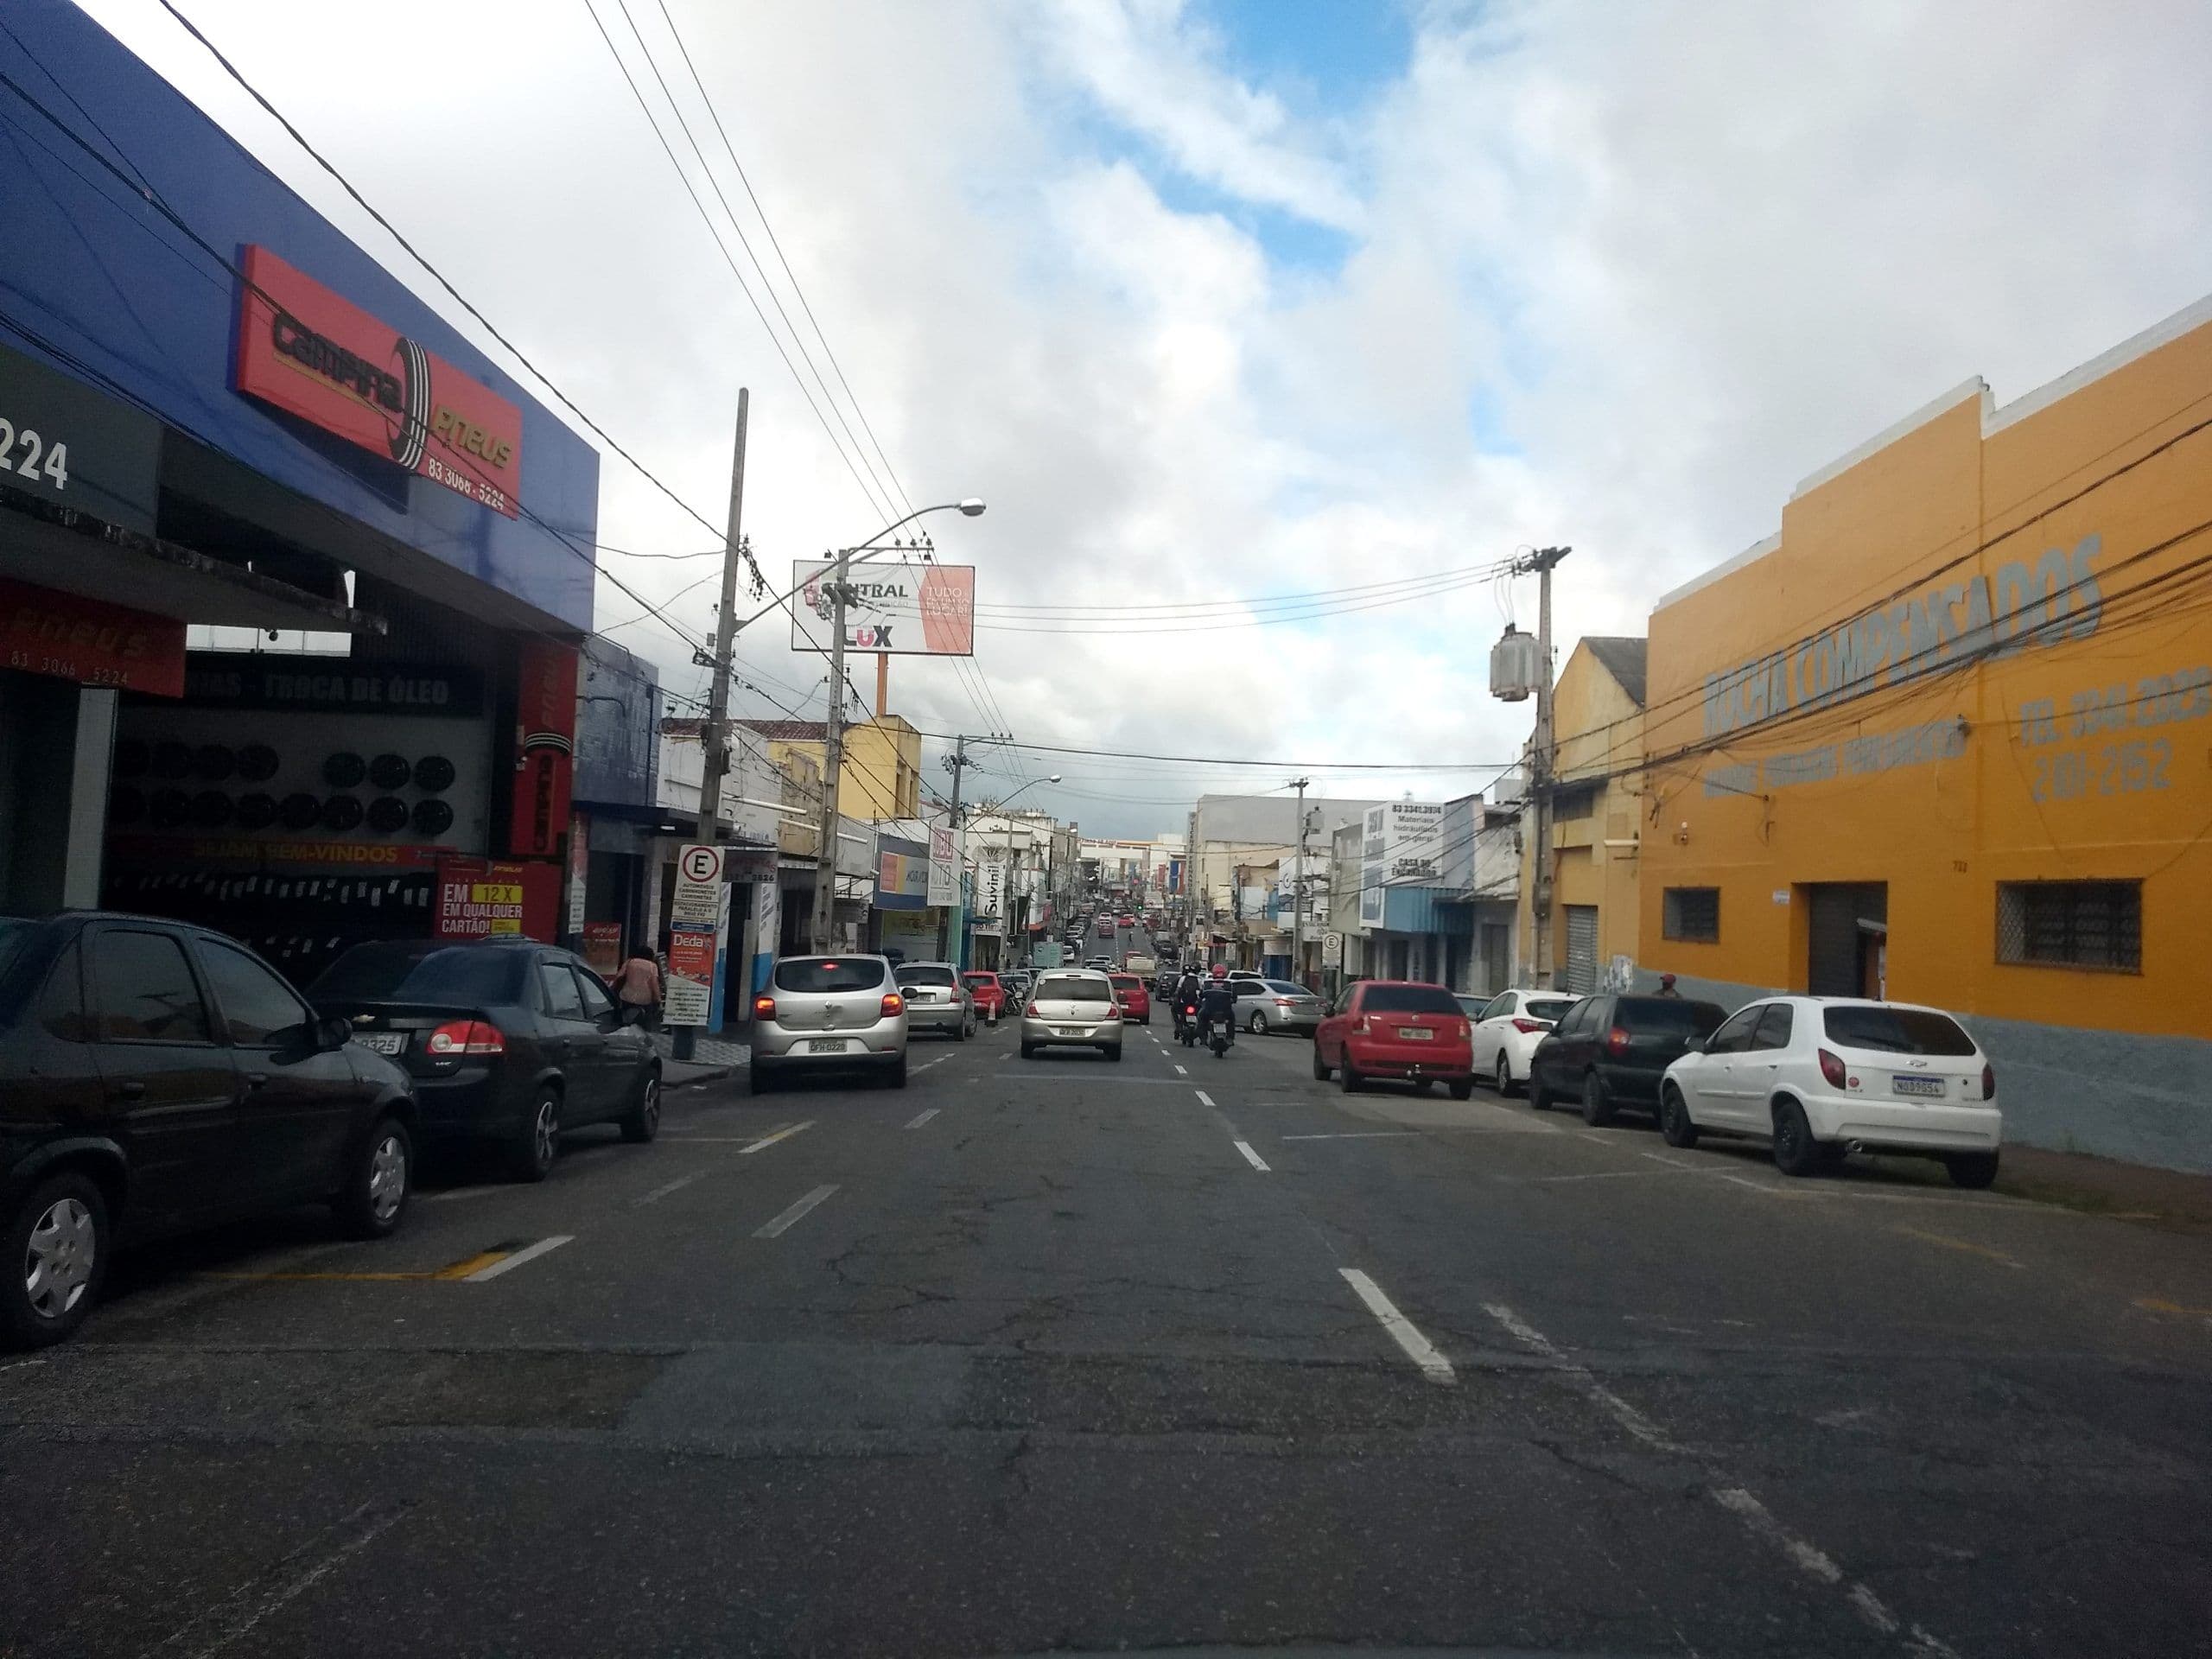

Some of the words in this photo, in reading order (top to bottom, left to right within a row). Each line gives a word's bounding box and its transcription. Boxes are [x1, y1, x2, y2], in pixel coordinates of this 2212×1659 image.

[429, 458, 442, 480] 83
[444, 467, 471, 494] 3066
[926, 587, 963, 598] TUDO
[11, 650, 29, 667] 83
[41, 657, 76, 677] 3066
[93, 667, 128, 684] 5224
[352, 677, 383, 703] DE
[387, 672, 449, 705] ÓLEO
[694, 855, 709, 874] E
[443, 884, 467, 903] EM
[483, 887, 500, 902] 12
[503, 887, 512, 901] X
[984, 865, 1000, 917] Suvinil
[442, 904, 461, 917] EM
[462, 904, 524, 918] QUALQUER
[442, 918, 491, 934] CARTÃO!
[673, 934, 704, 948] Deda
